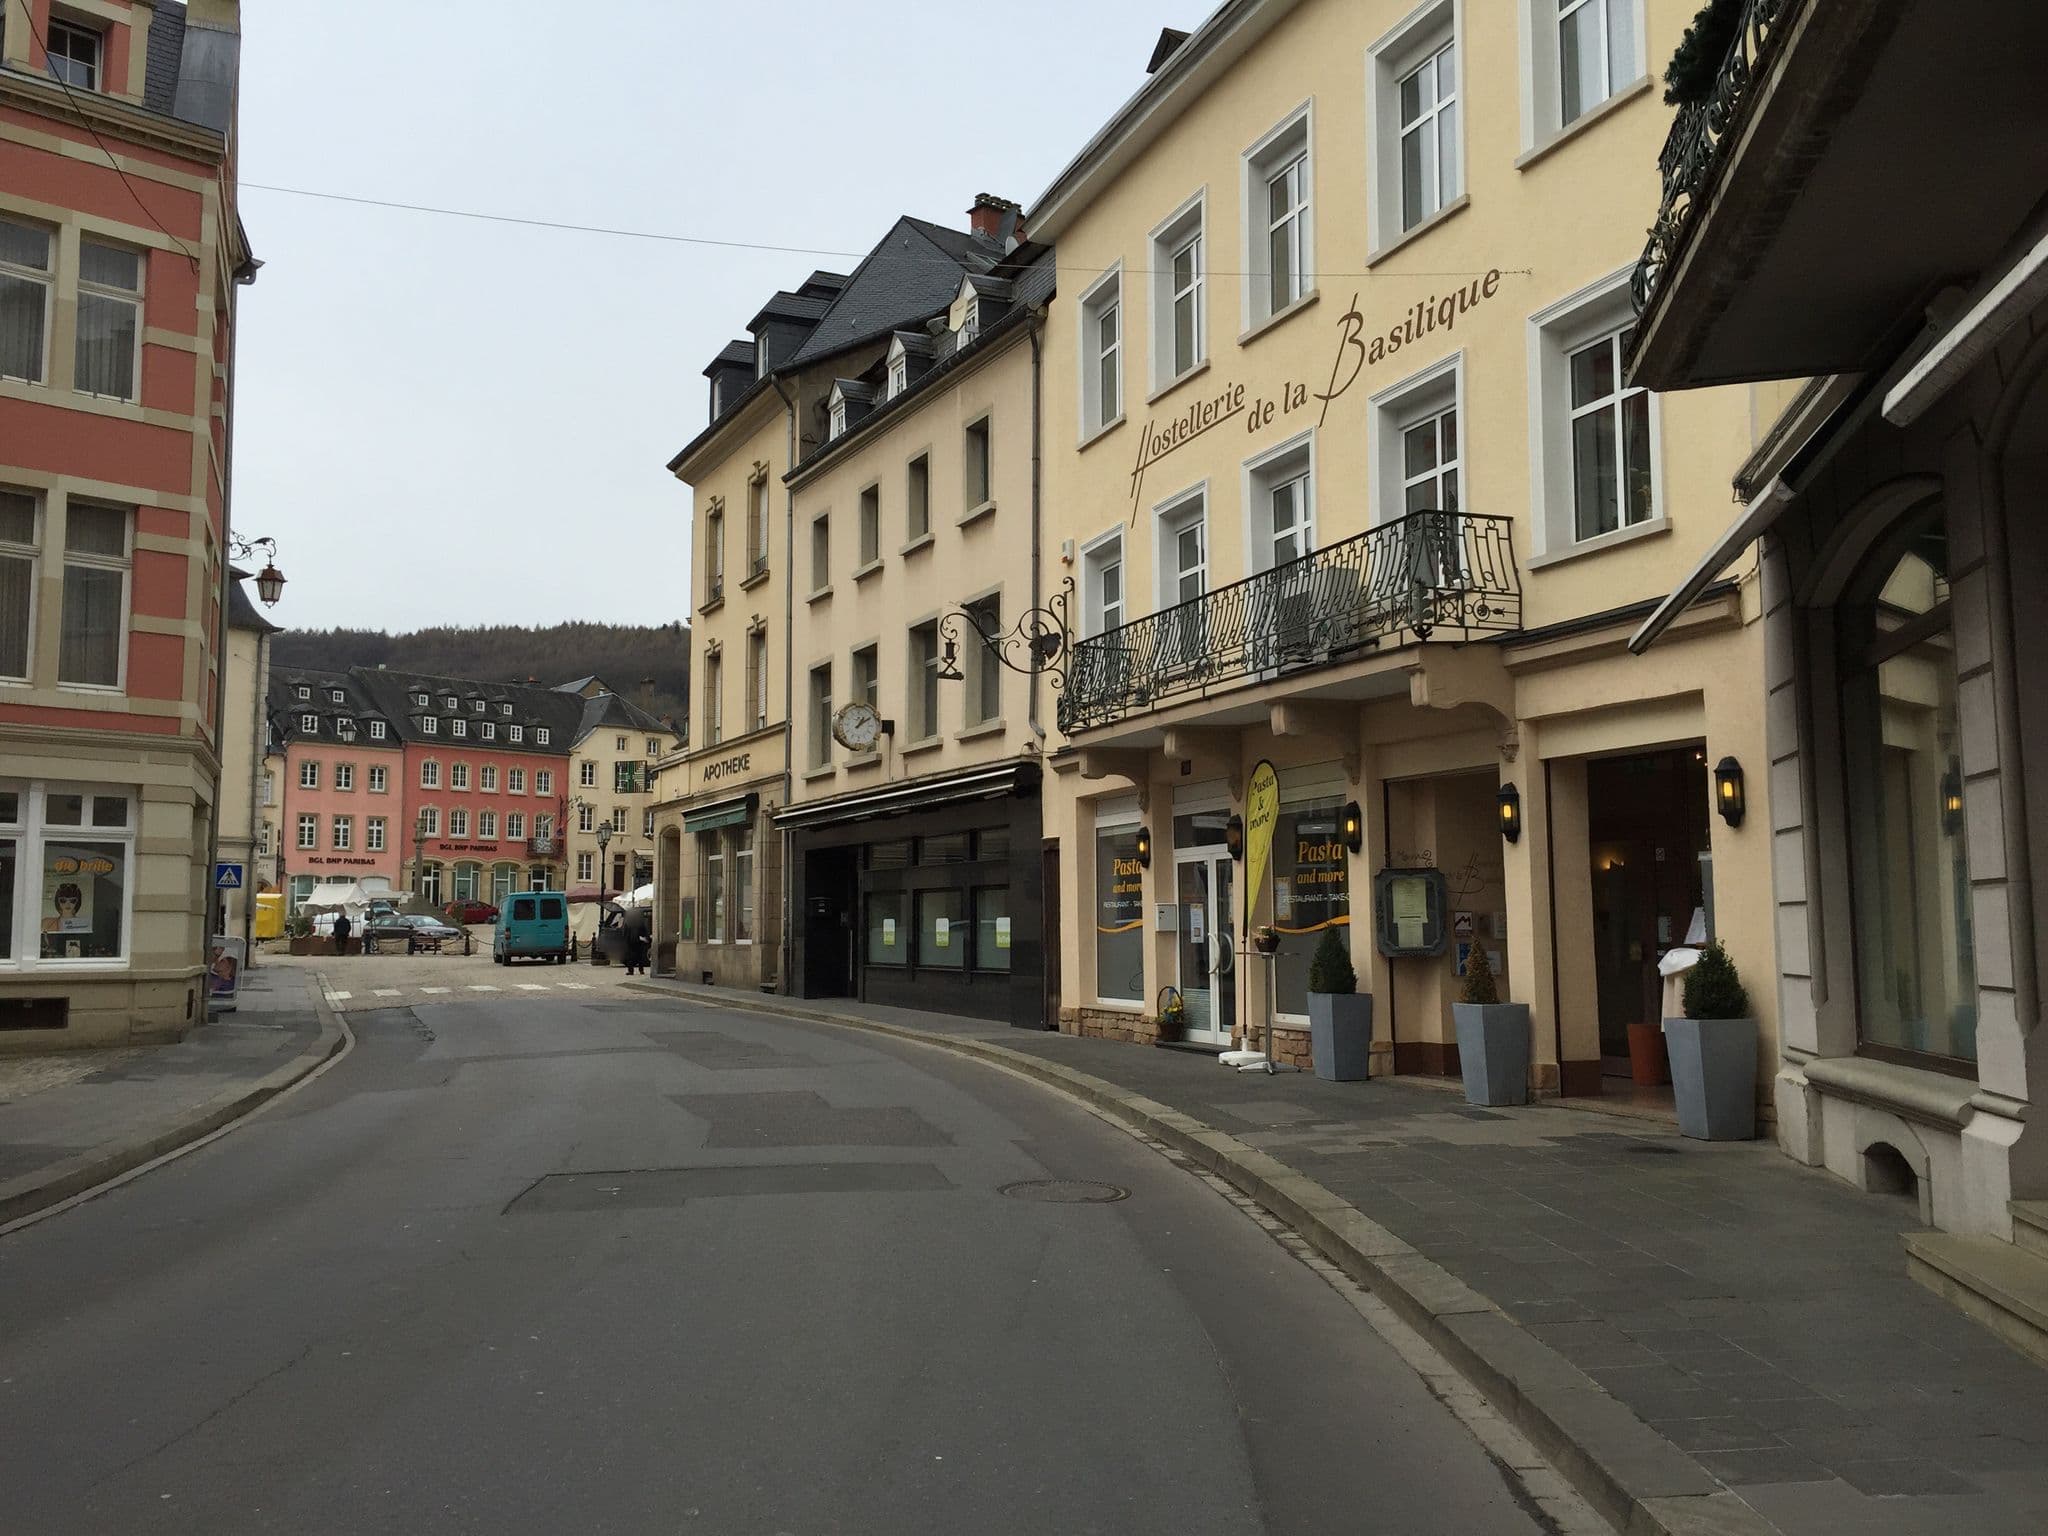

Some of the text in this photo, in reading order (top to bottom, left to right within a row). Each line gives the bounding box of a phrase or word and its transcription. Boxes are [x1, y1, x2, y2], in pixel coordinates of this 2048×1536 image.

[1131, 267, 1500, 529] Hostellerie de la Basilique
[703, 753, 751, 782] APOTHEKE
[308, 856, 376, 866] BGL BNP PARIBAS
[1298, 840, 1343, 864] Pasta
[1297, 868, 1345, 884] and more
[1112, 881, 1126, 894] and
